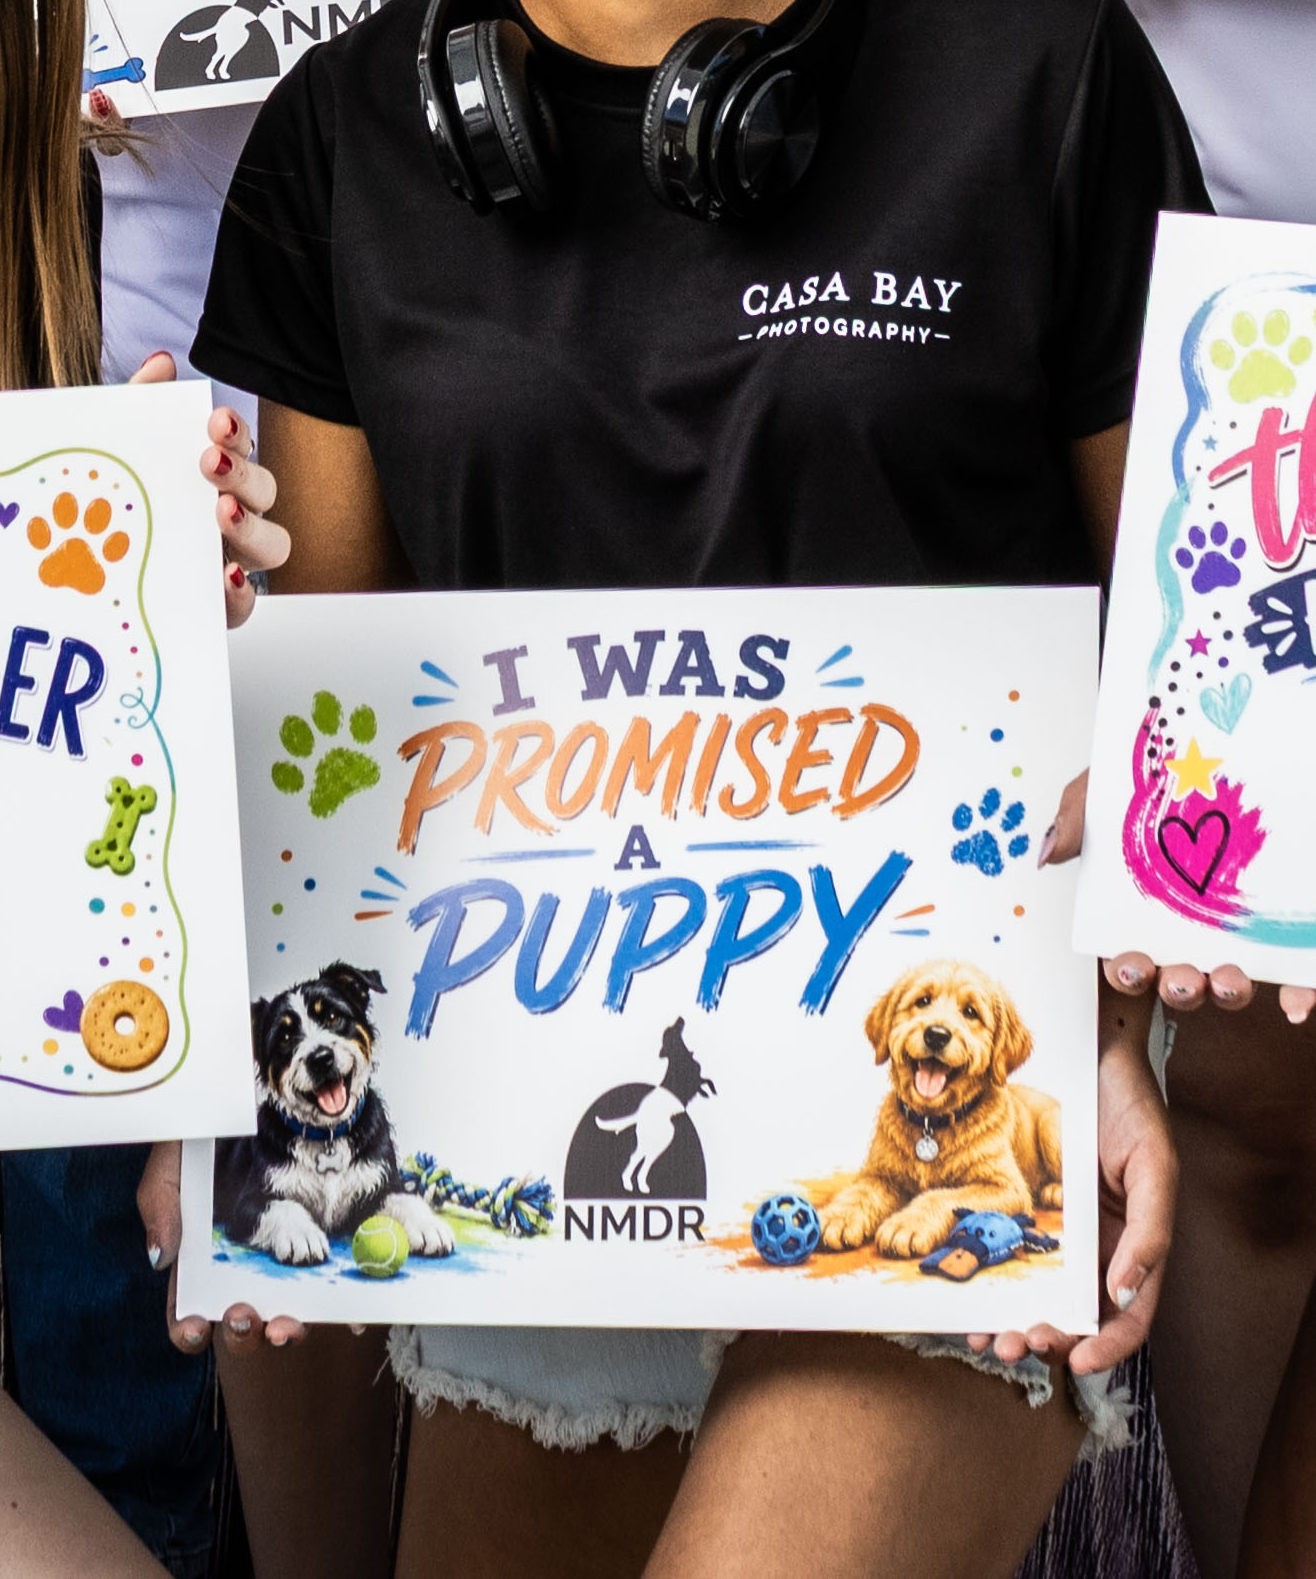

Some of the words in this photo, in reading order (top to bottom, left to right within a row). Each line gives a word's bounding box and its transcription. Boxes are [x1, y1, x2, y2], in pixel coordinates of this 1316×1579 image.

[742, 271, 850, 316] CASA
[871, 271, 962, 312] BAY
[483, 646, 536, 716] I
[567, 629, 791, 702] WAS
[397, 704, 921, 855] PROMISED
[614, 824, 662, 871] A
[405, 851, 913, 1040] PUPPY
[564, 1204, 706, 1242] NMDR
